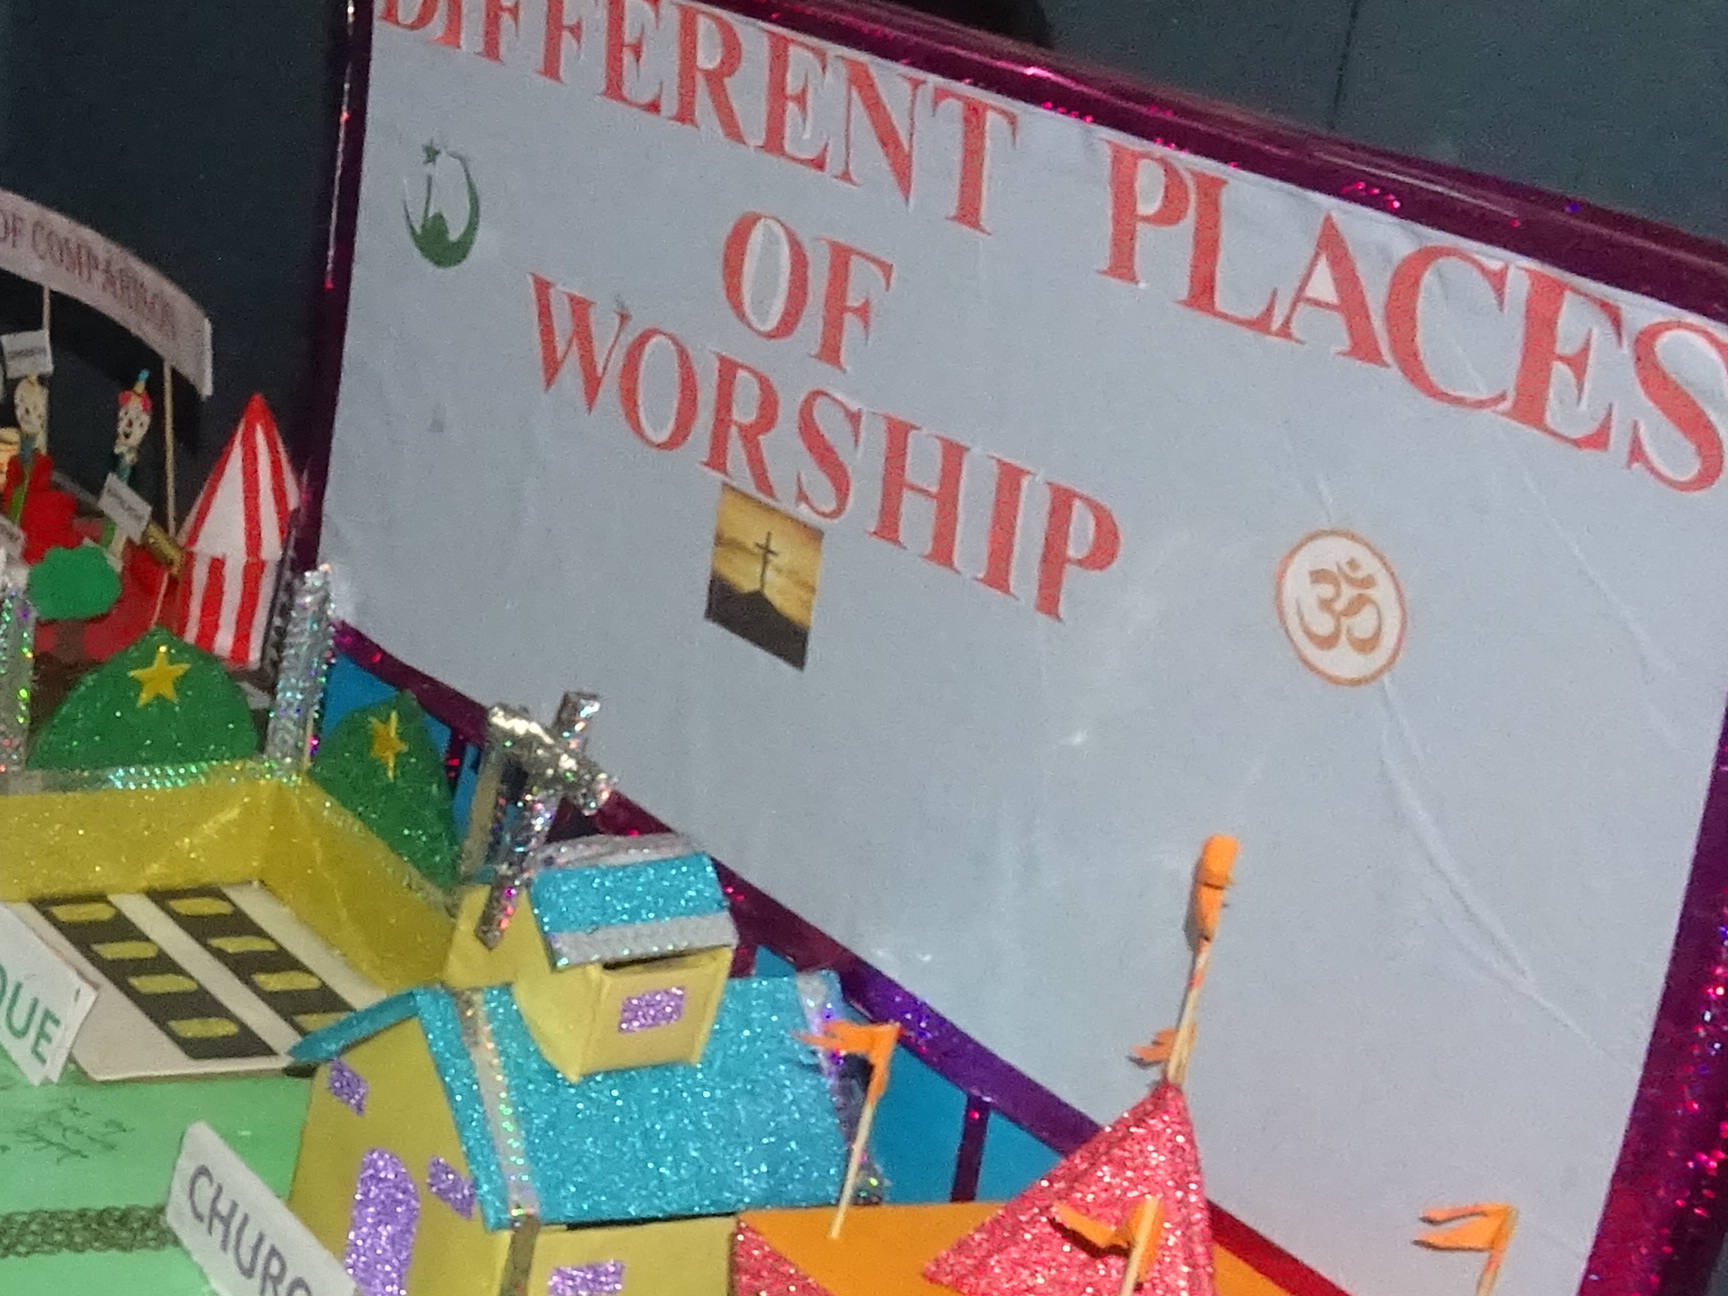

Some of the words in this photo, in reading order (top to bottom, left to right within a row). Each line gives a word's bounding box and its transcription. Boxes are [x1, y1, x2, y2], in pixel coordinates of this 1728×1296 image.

[530, 273, 1126, 621] WORSHIP
[722, 209, 894, 374] OF
[1101, 139, 1728, 494] PLACES
